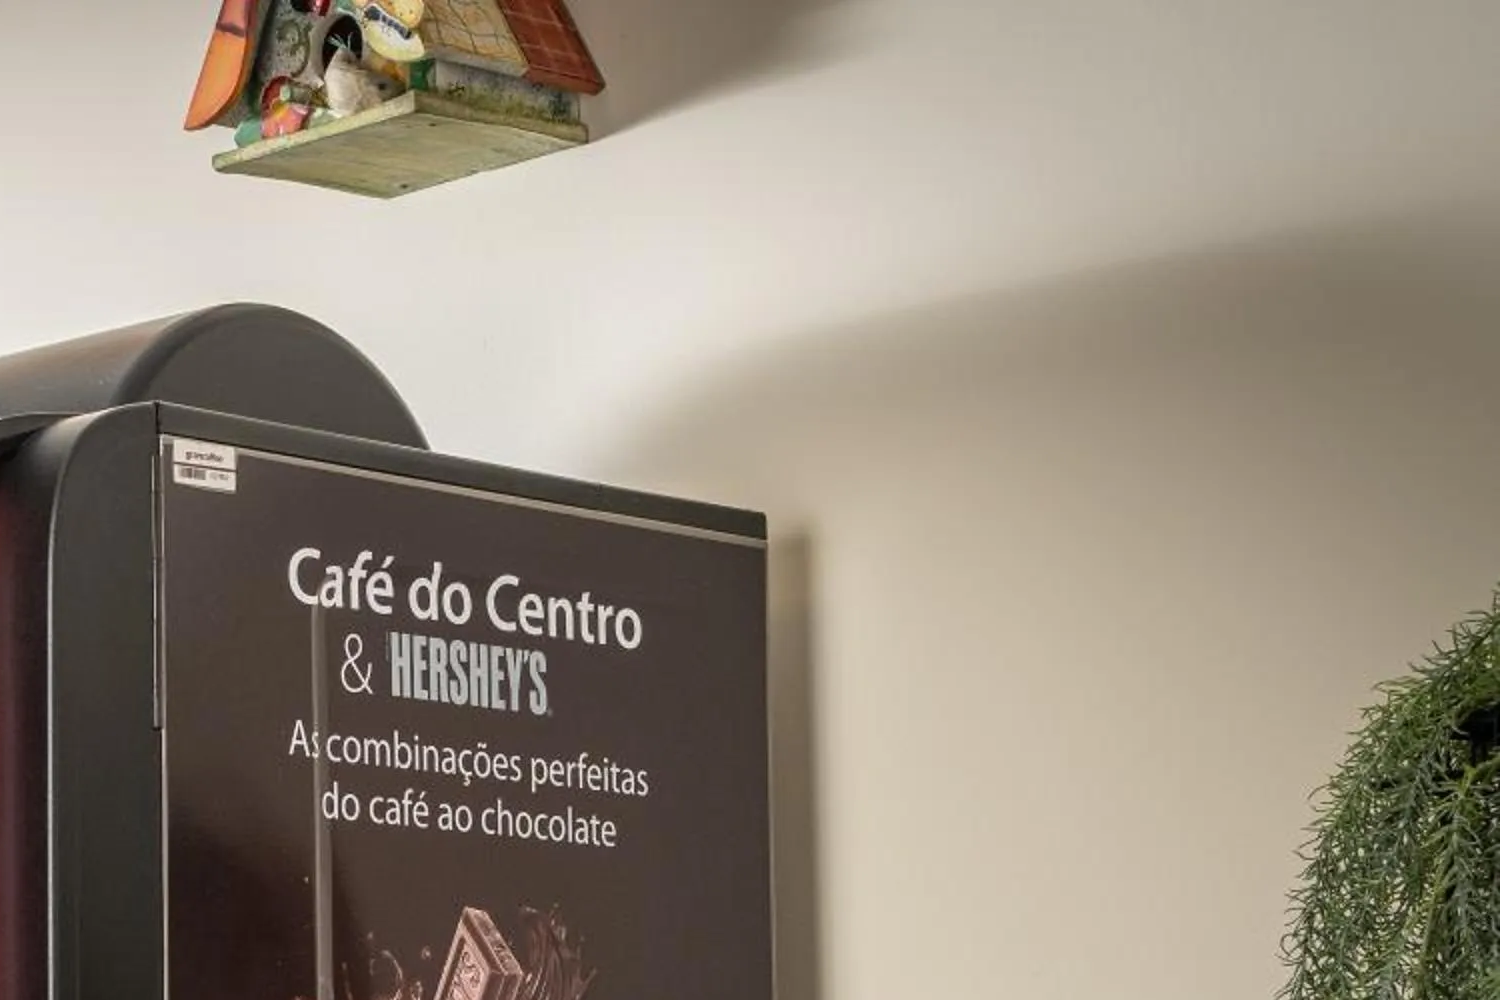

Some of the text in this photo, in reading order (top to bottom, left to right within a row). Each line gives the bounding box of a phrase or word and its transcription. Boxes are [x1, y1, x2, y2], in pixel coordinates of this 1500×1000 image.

[288, 547, 642, 649] Café do Centro
[340, 631, 548, 716] & HERSHEY'S
[288, 719, 649, 796] As combinações perfeitas
[321, 780, 617, 847] do café ao chocolate
